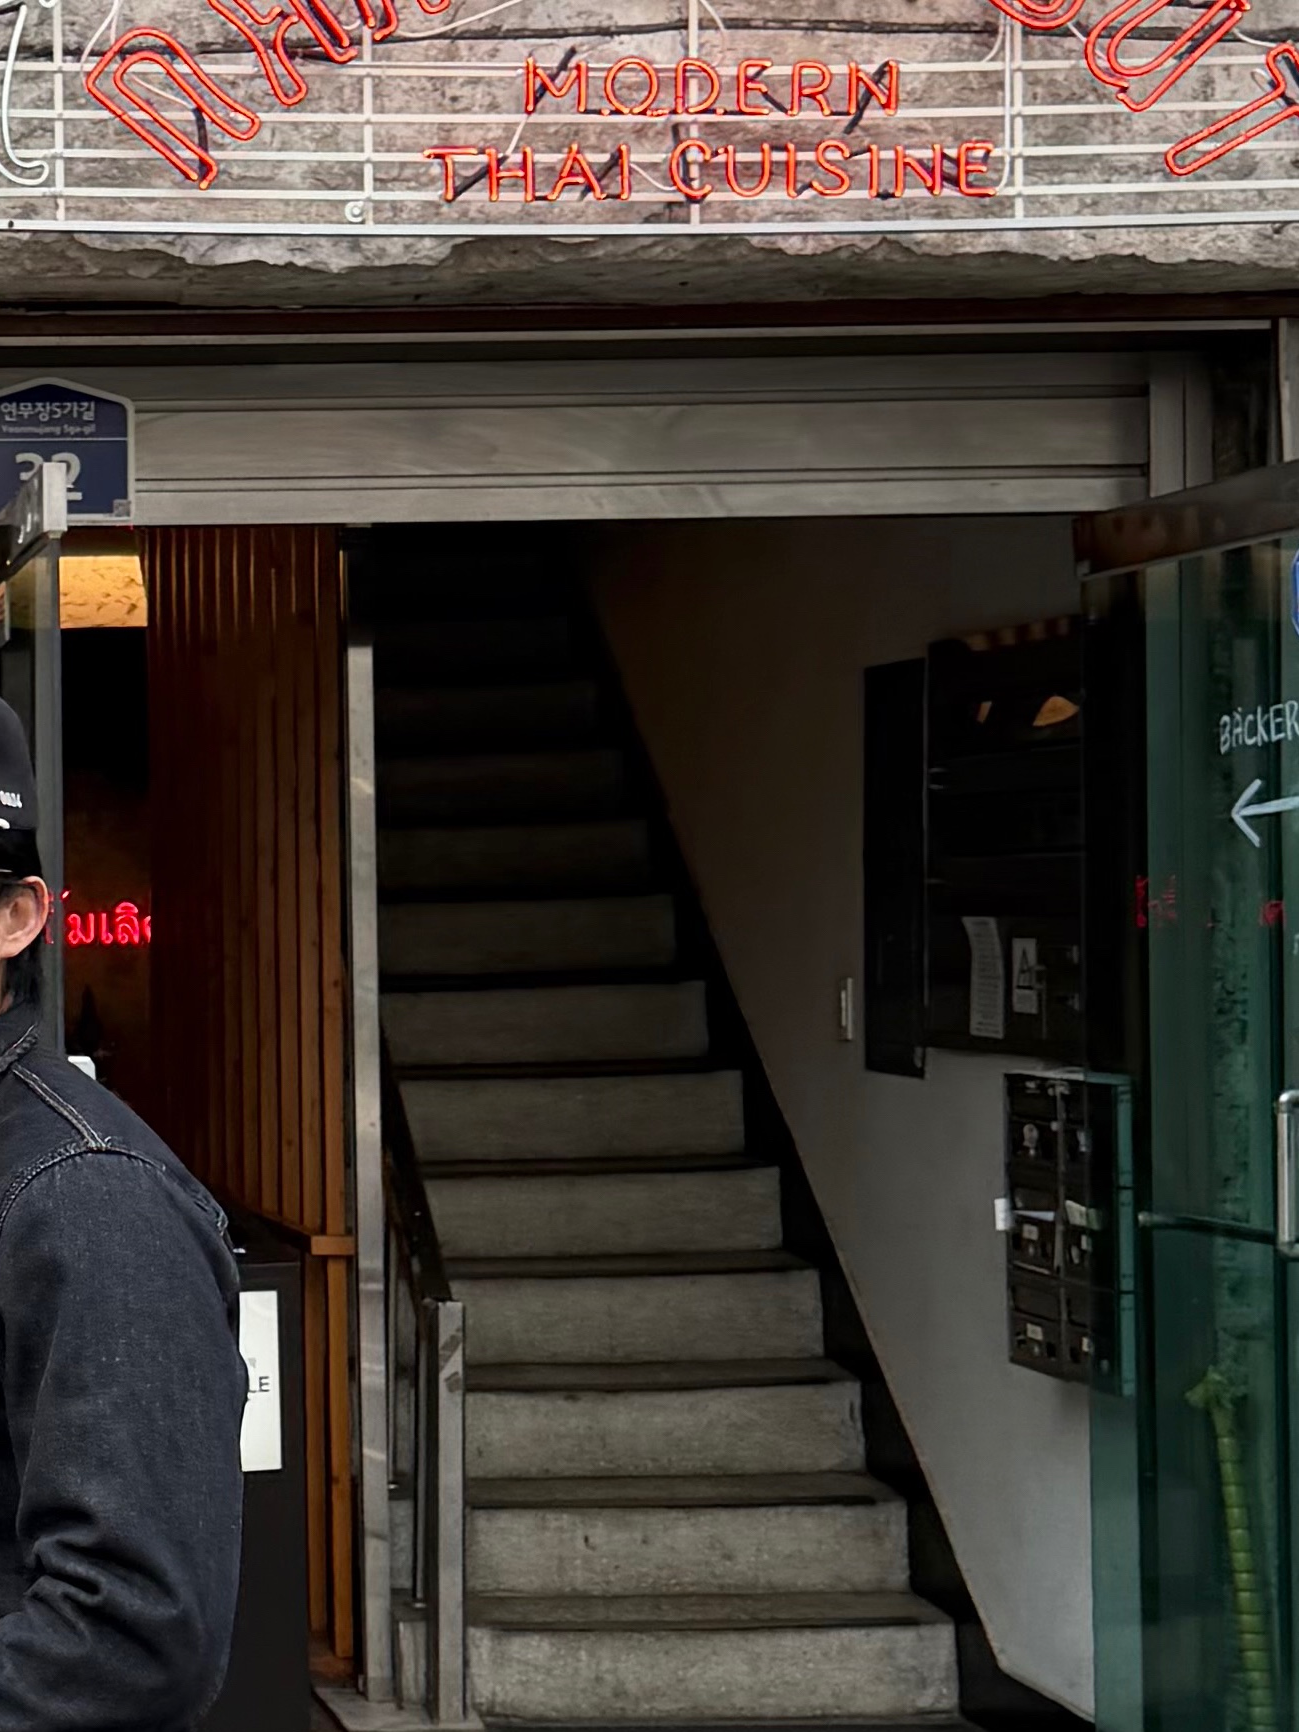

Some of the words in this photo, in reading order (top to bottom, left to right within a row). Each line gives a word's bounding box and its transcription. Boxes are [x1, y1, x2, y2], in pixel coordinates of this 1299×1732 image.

[525, 55, 900, 117] MODERN
[424, 142, 631, 202] THAI
[668, 138, 997, 200] CUISINE
[0, 401, 96, 423] 연무장5가길
